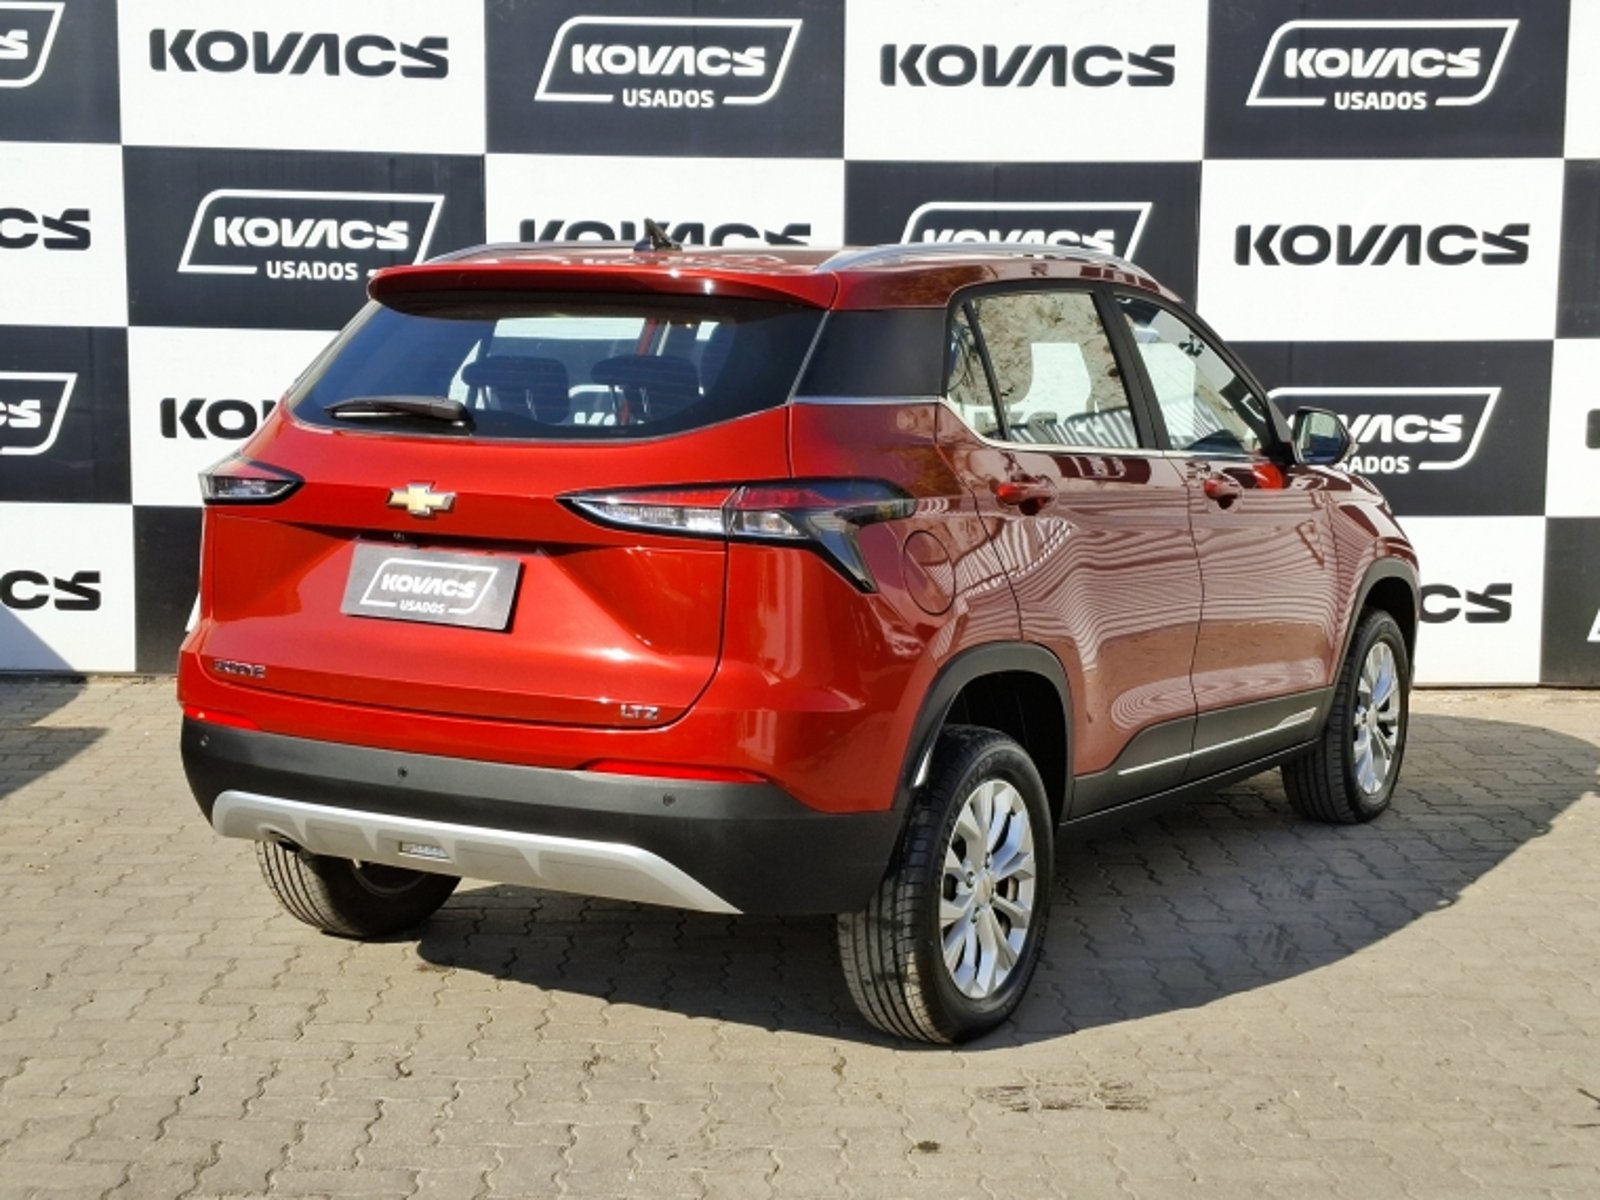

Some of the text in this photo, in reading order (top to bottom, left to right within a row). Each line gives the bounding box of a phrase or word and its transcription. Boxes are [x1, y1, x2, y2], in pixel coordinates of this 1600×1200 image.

[149, 29, 449, 79] KOVACS
[570, 43, 767, 78] KOVACS
[881, 44, 1175, 87] KOVACS
[1284, 47, 1481, 79] KOVACS
[622, 88, 715, 109] USADOS
[1334, 91, 1428, 111] USADOS
[213, 216, 409, 251] KOVACS
[1235, 223, 1530, 266] KOVACS
[266, 260, 359, 281] USADOS
[380, 573, 478, 599] KOVACS
[399, 599, 446, 614] USADOS
[620, 704, 659, 721] LTZ
